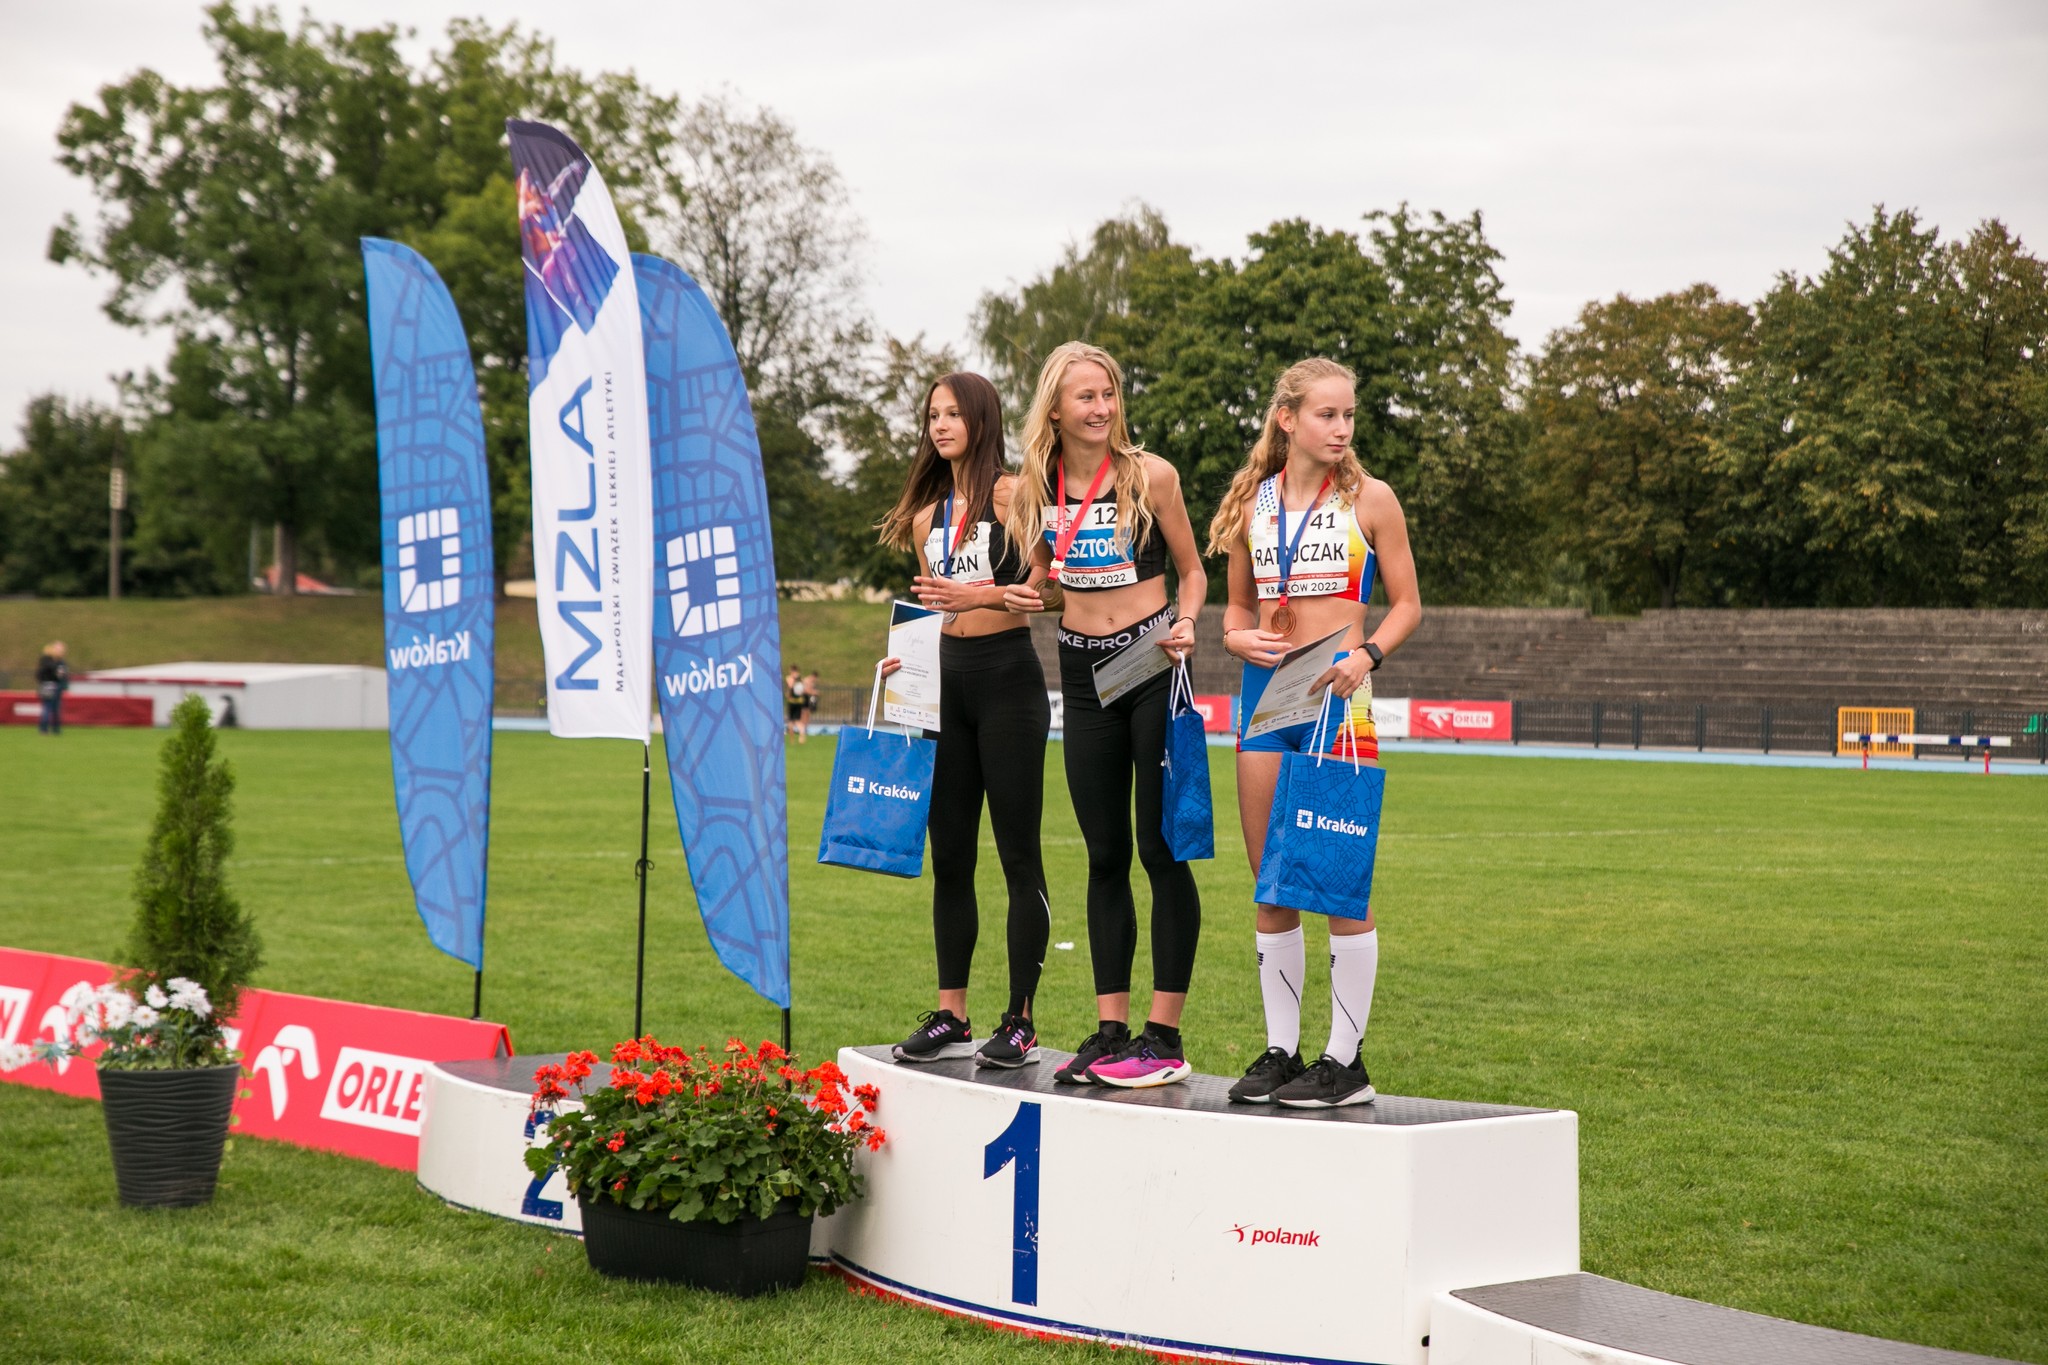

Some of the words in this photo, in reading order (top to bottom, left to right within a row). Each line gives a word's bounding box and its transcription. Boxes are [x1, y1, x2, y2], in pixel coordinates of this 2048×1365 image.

[605, 371, 615, 440] ATLETYKI
[608, 451, 618, 507] LEKKIEJ
[1310, 512, 1336, 529] 41
[554, 375, 603, 690] MZLA
[609, 517, 621, 584] ZWIĄZEK
[1255, 543, 1345, 567] RATJCZAK
[1100, 573, 1126, 585] 2022
[1311, 581, 1338, 592] 2022
[1087, 633, 1132, 650] PRO
[1455, 714, 1489, 724] ORLEN
[869, 781, 921, 801] Kraków
[1316, 815, 1368, 837] Kraków
[337, 1061, 423, 1122] ORLE
[521, 1110, 565, 1221] 2
[984, 1101, 1041, 1307] 1
[1251, 1227, 1320, 1247] polanik
